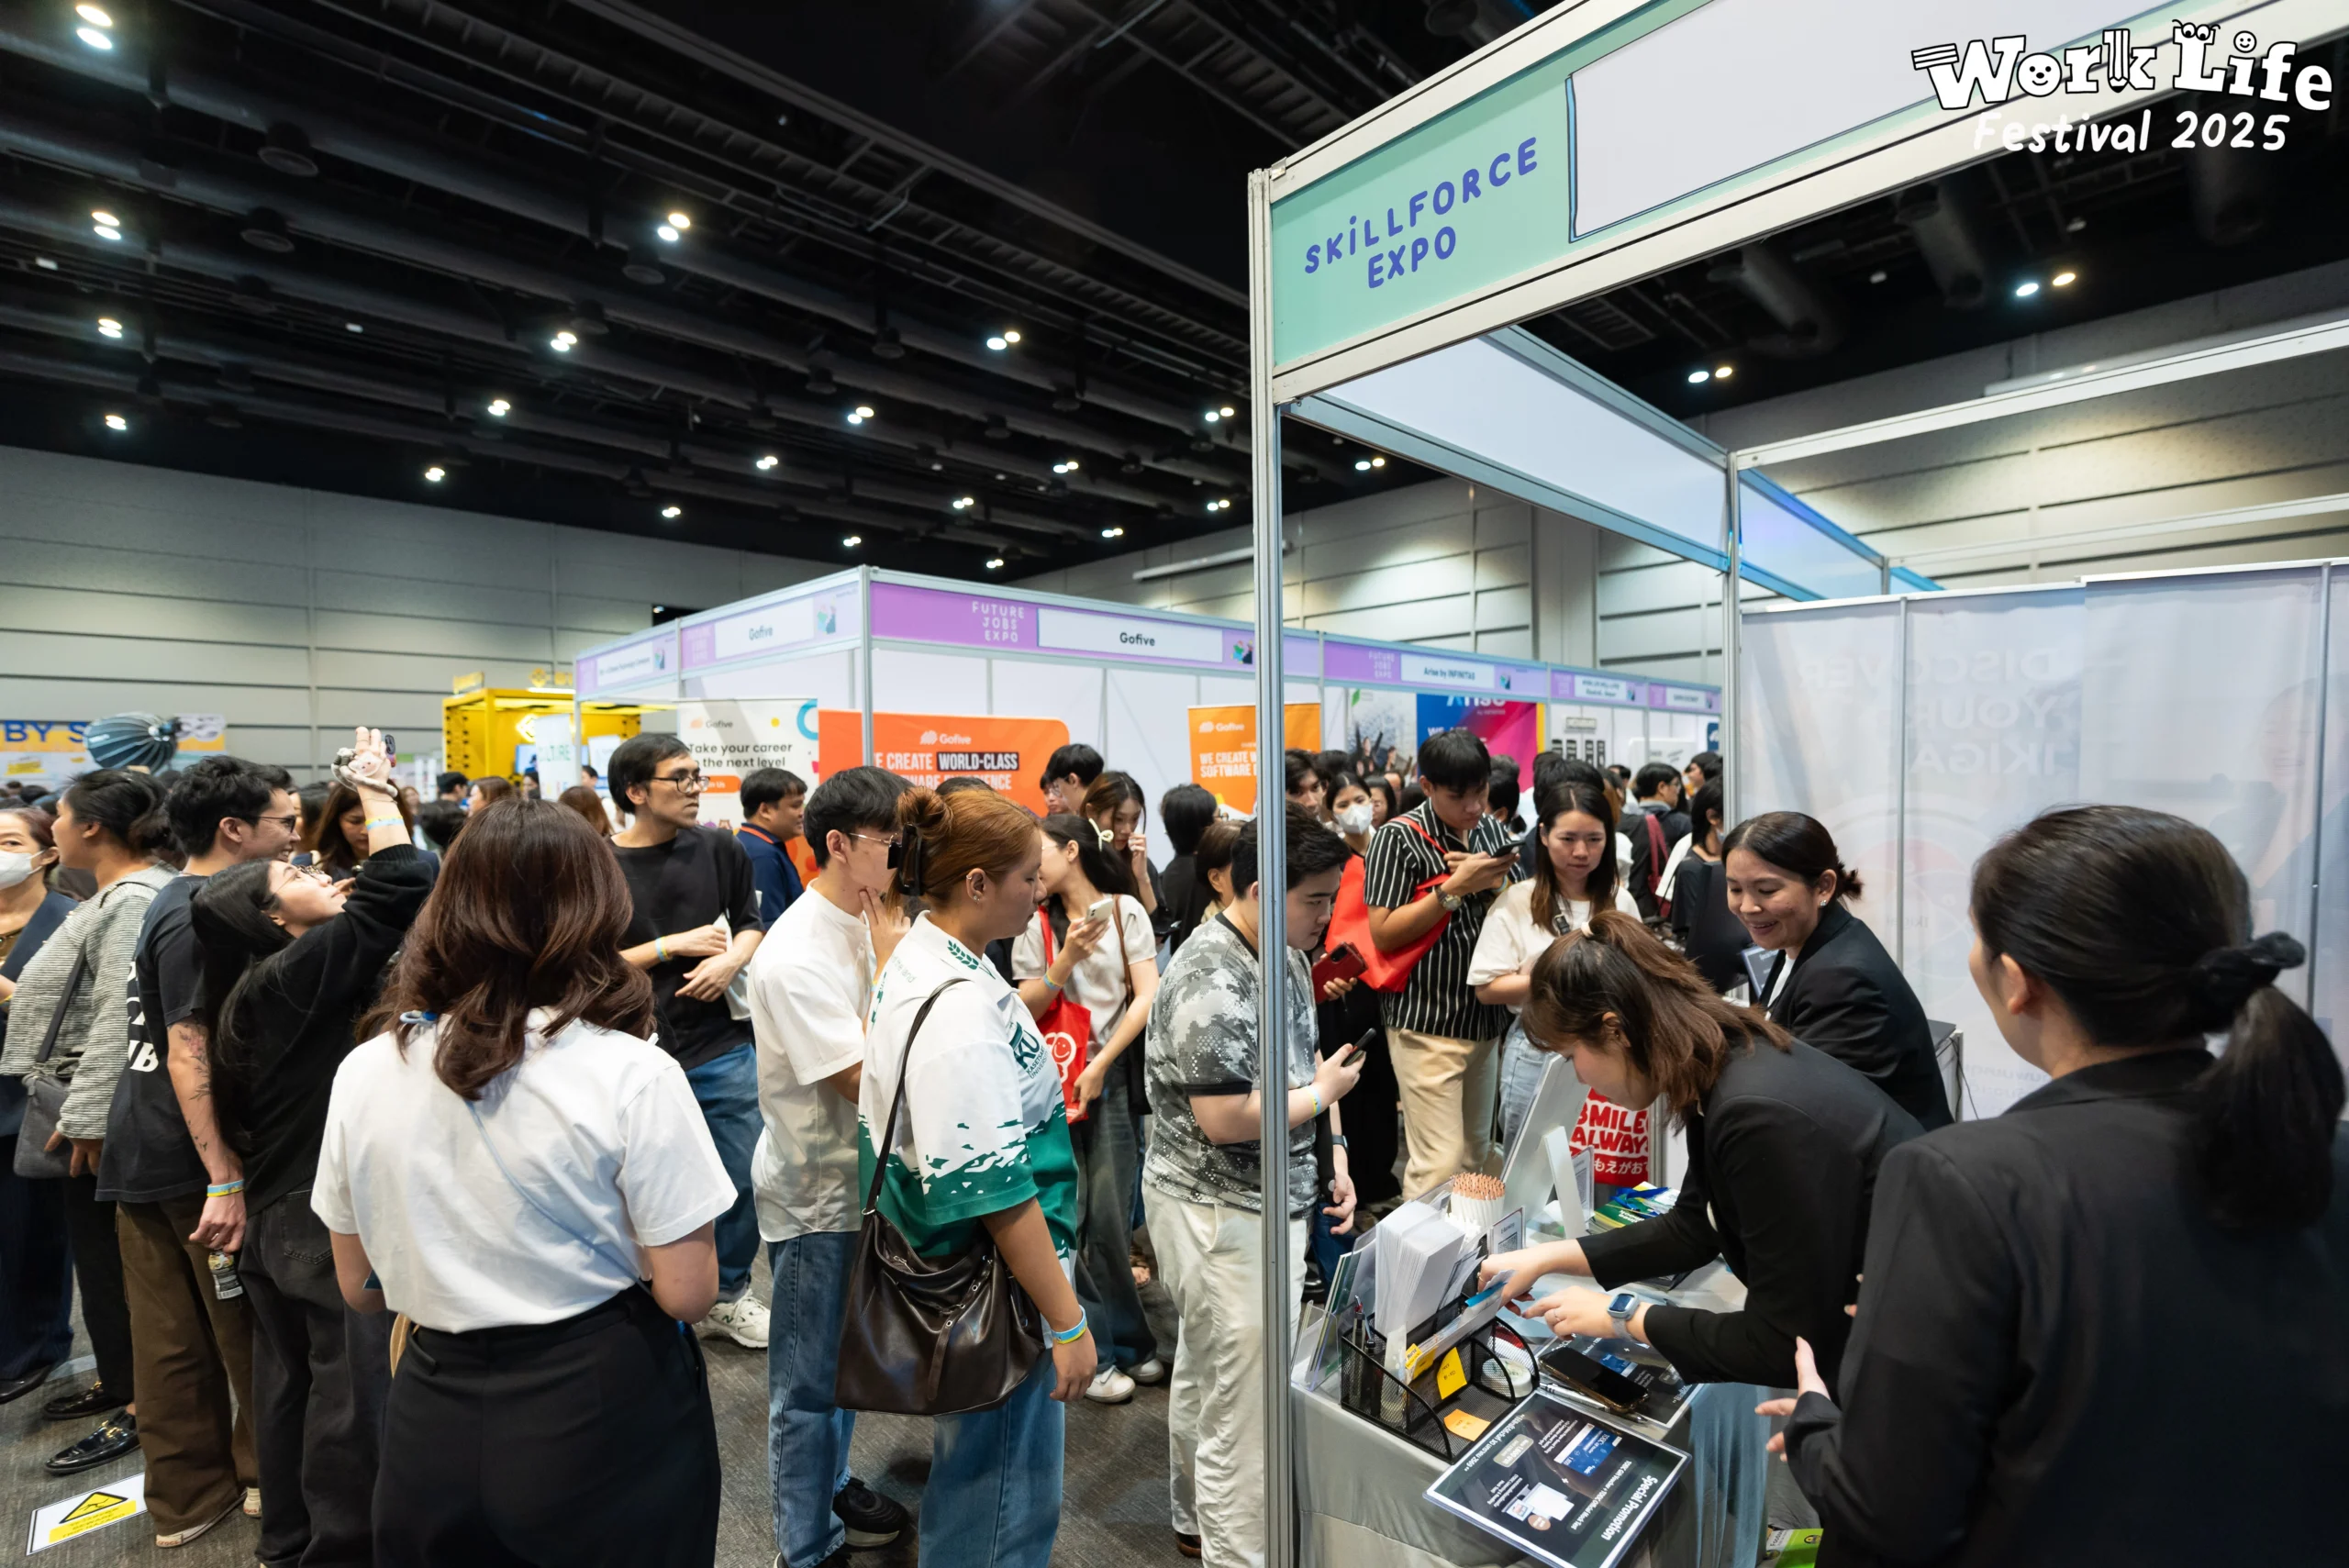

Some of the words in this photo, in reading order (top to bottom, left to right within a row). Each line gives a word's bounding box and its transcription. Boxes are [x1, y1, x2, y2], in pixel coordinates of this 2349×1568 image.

[1368, 226, 1456, 288] EXPO
[972, 601, 1024, 619] FUTURE
[982, 618, 1018, 631] JOBS
[749, 625, 774, 641] Gofive
[985, 629, 1019, 643] EXPO
[1119, 632, 1155, 647] Gofive
[1424, 667, 1438, 677] Arise
[1440, 668, 1447, 679] by
[4, 720, 54, 743] BY
[706, 719, 733, 729] Gofive
[1216, 722, 1245, 732] Gofive
[939, 733, 972, 745] Gofive
[689, 743, 718, 754] Take
[720, 744, 749, 756] your
[752, 743, 793, 753] career
[703, 757, 723, 768] the
[726, 757, 755, 768] next
[757, 757, 786, 769] level
[886, 752, 933, 771] CREATE
[938, 752, 1019, 771] WORLD-CLASS
[1199, 752, 1214, 764] WE
[1215, 751, 1250, 763] CREATE
[1200, 763, 1252, 778] SOFTWARE
[1013, 1029, 1041, 1071] KU
[1026, 1045, 1046, 1076] KASETSART
[1570, 1127, 1649, 1155] ALWAY
[1620, 1460, 1632, 1470] TOEIC
[1603, 1474, 1620, 1489] Voucher
[1627, 1473, 1659, 1503] Special
[1593, 1489, 1607, 1501] TOEIC
[1599, 1499, 1640, 1541] Promotion
